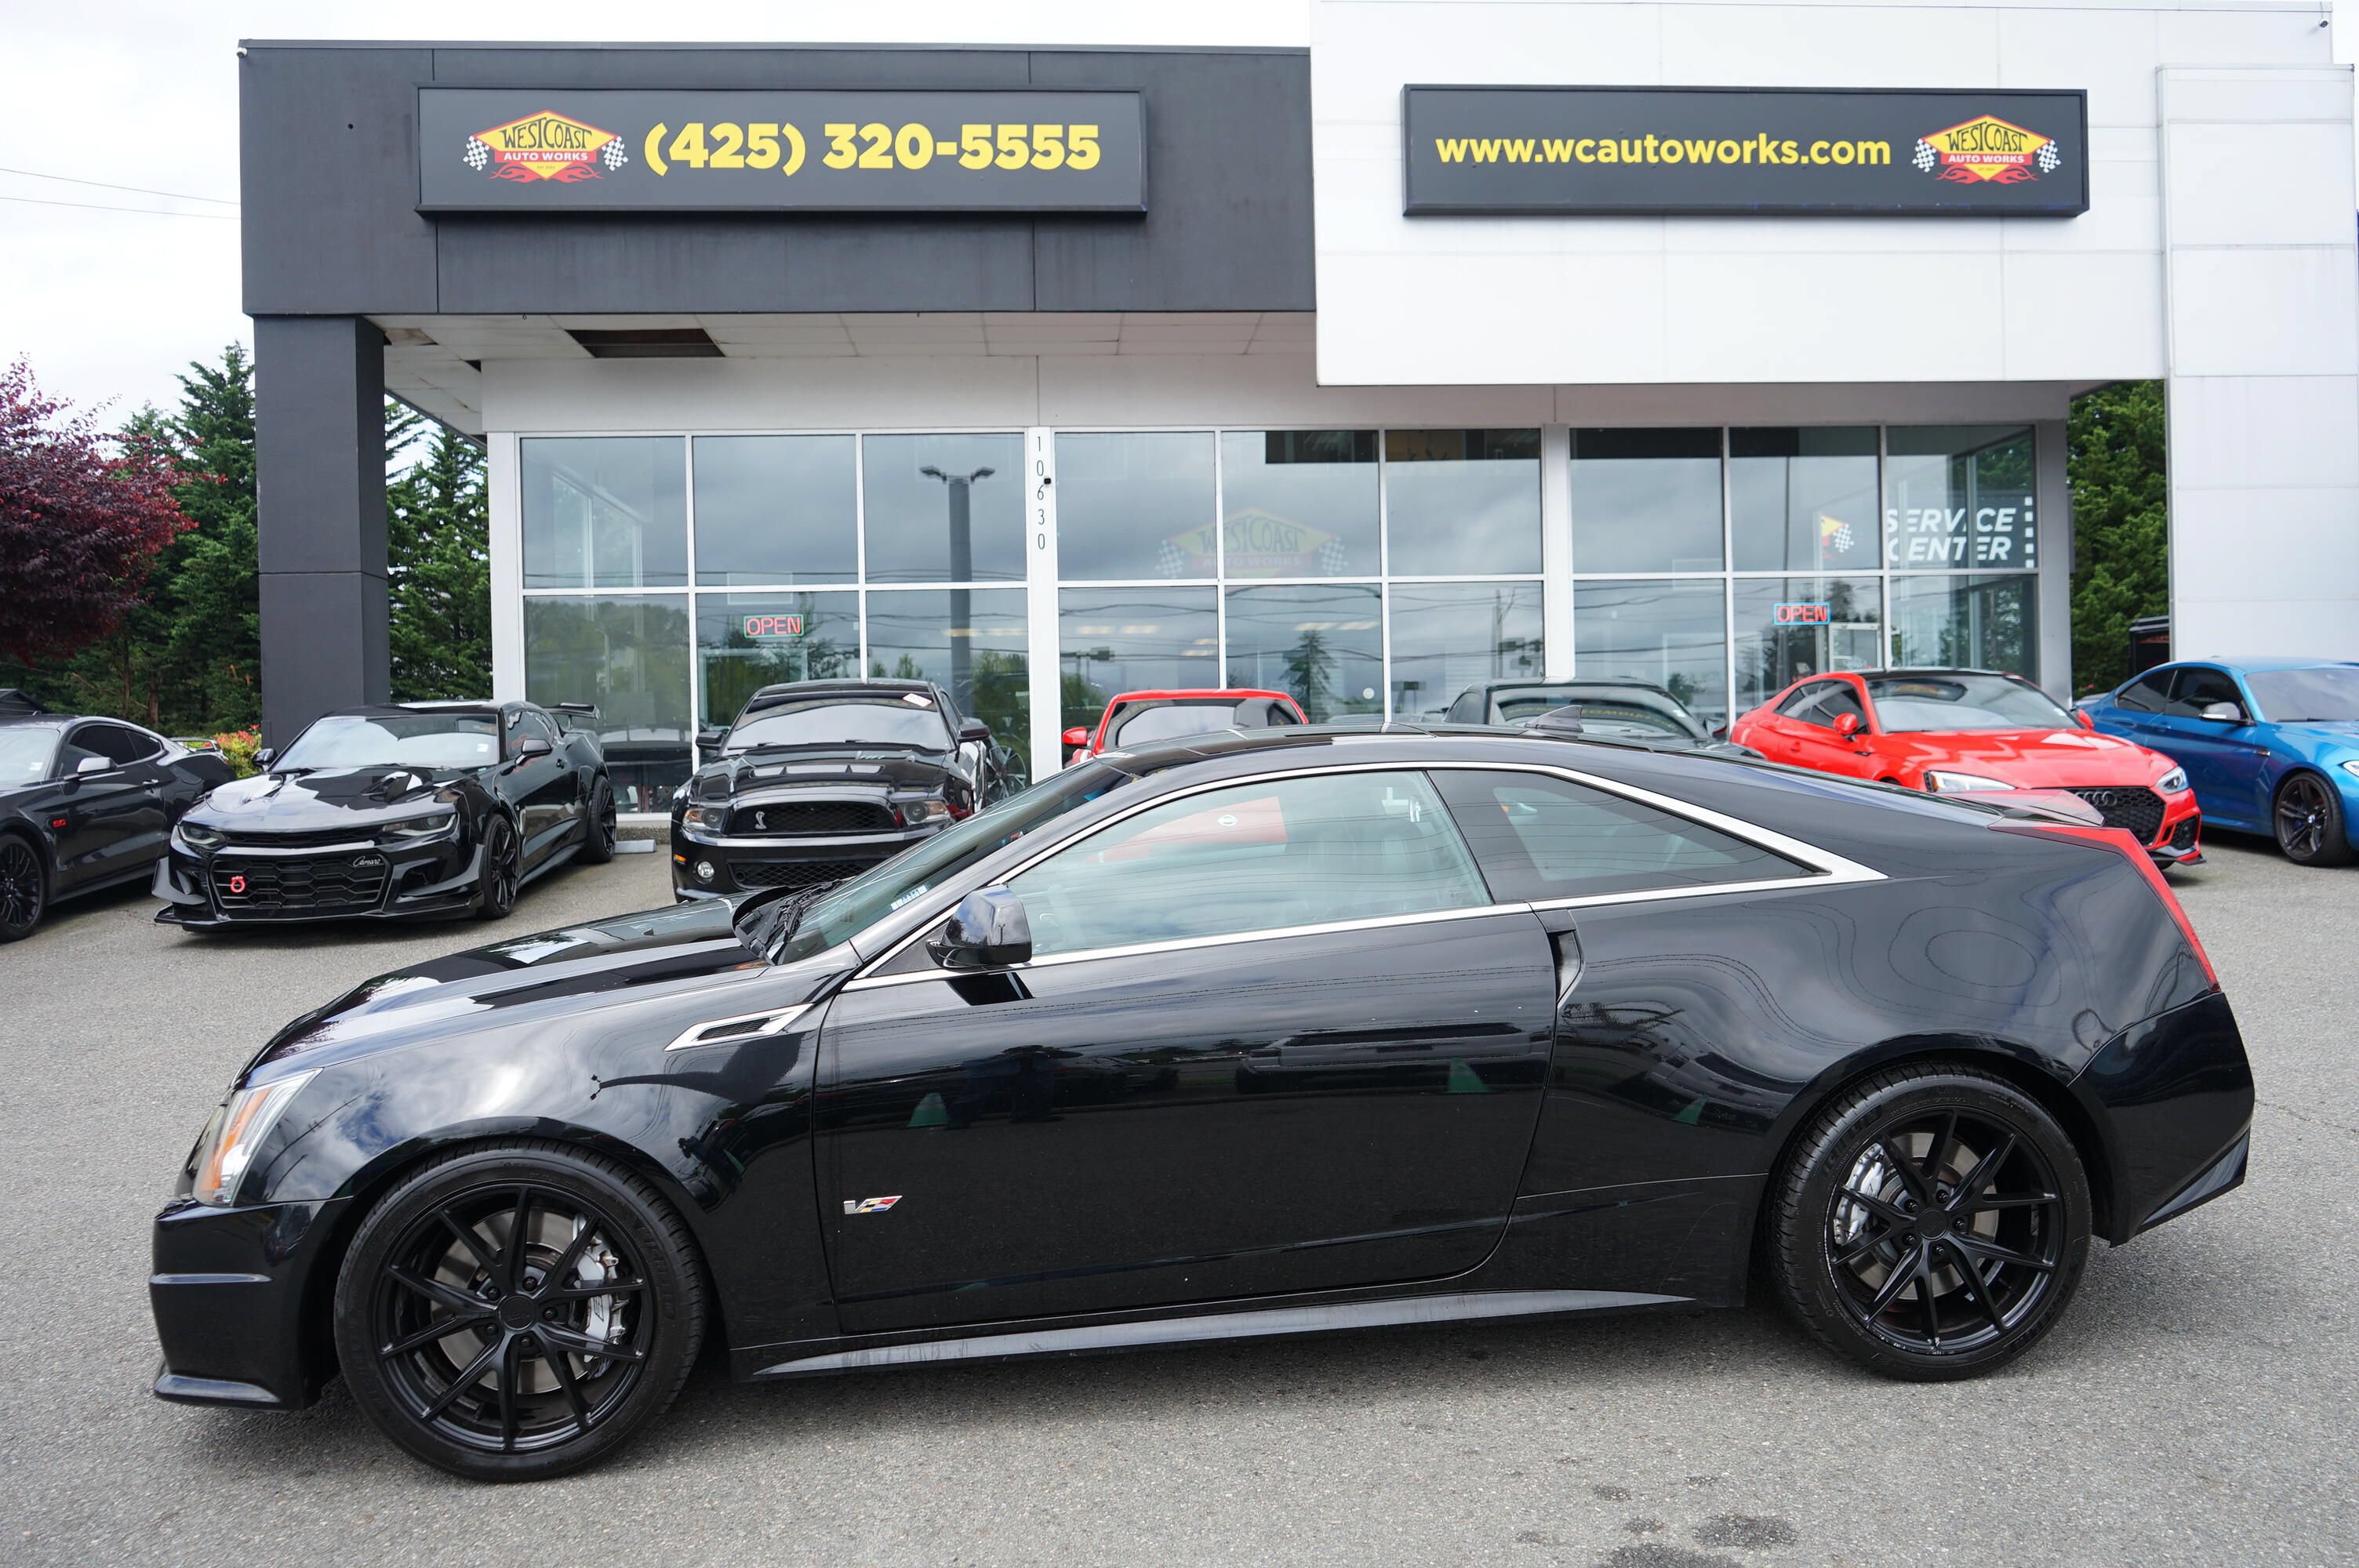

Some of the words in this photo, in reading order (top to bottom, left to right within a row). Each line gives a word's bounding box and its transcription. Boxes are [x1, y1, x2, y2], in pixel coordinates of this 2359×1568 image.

[503, 152, 539, 162] AUTO
[541, 152, 588, 162] WORKS
[644, 122, 806, 177] (425)
[822, 122, 1102, 171] 320-5555
[1435, 132, 1892, 165] www.wcautoworks.com
[1948, 154, 1981, 163] AUTO
[1982, 154, 2025, 164] WORKS
[1887, 507, 2017, 534] SERVCE
[1777, 605, 1826, 622] OPEN
[747, 617, 801, 635] OPEN
